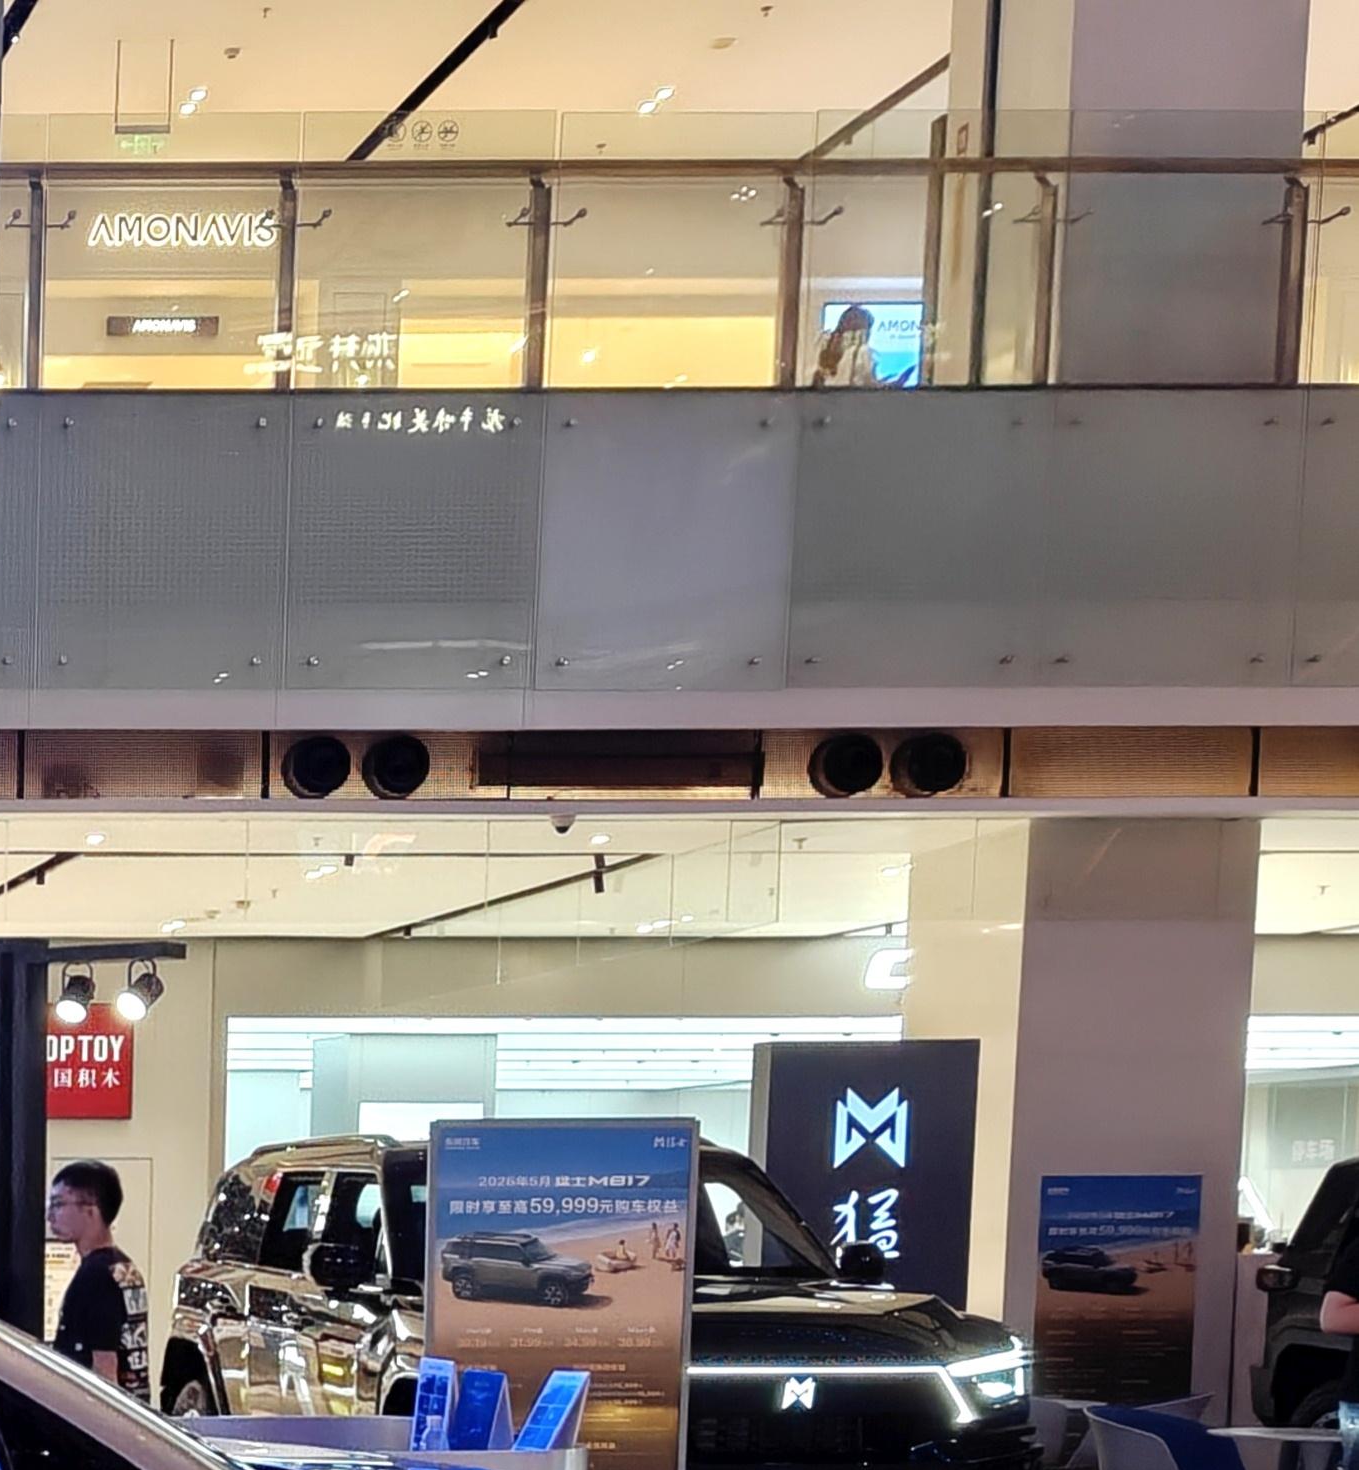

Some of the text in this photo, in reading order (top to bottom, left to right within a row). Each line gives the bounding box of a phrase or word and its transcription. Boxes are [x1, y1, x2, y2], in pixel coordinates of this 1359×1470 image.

[89, 213, 277, 247] AMONAVIS
[46, 1034, 75, 1062] OP
[53, 1067, 121, 1089] 国积木
